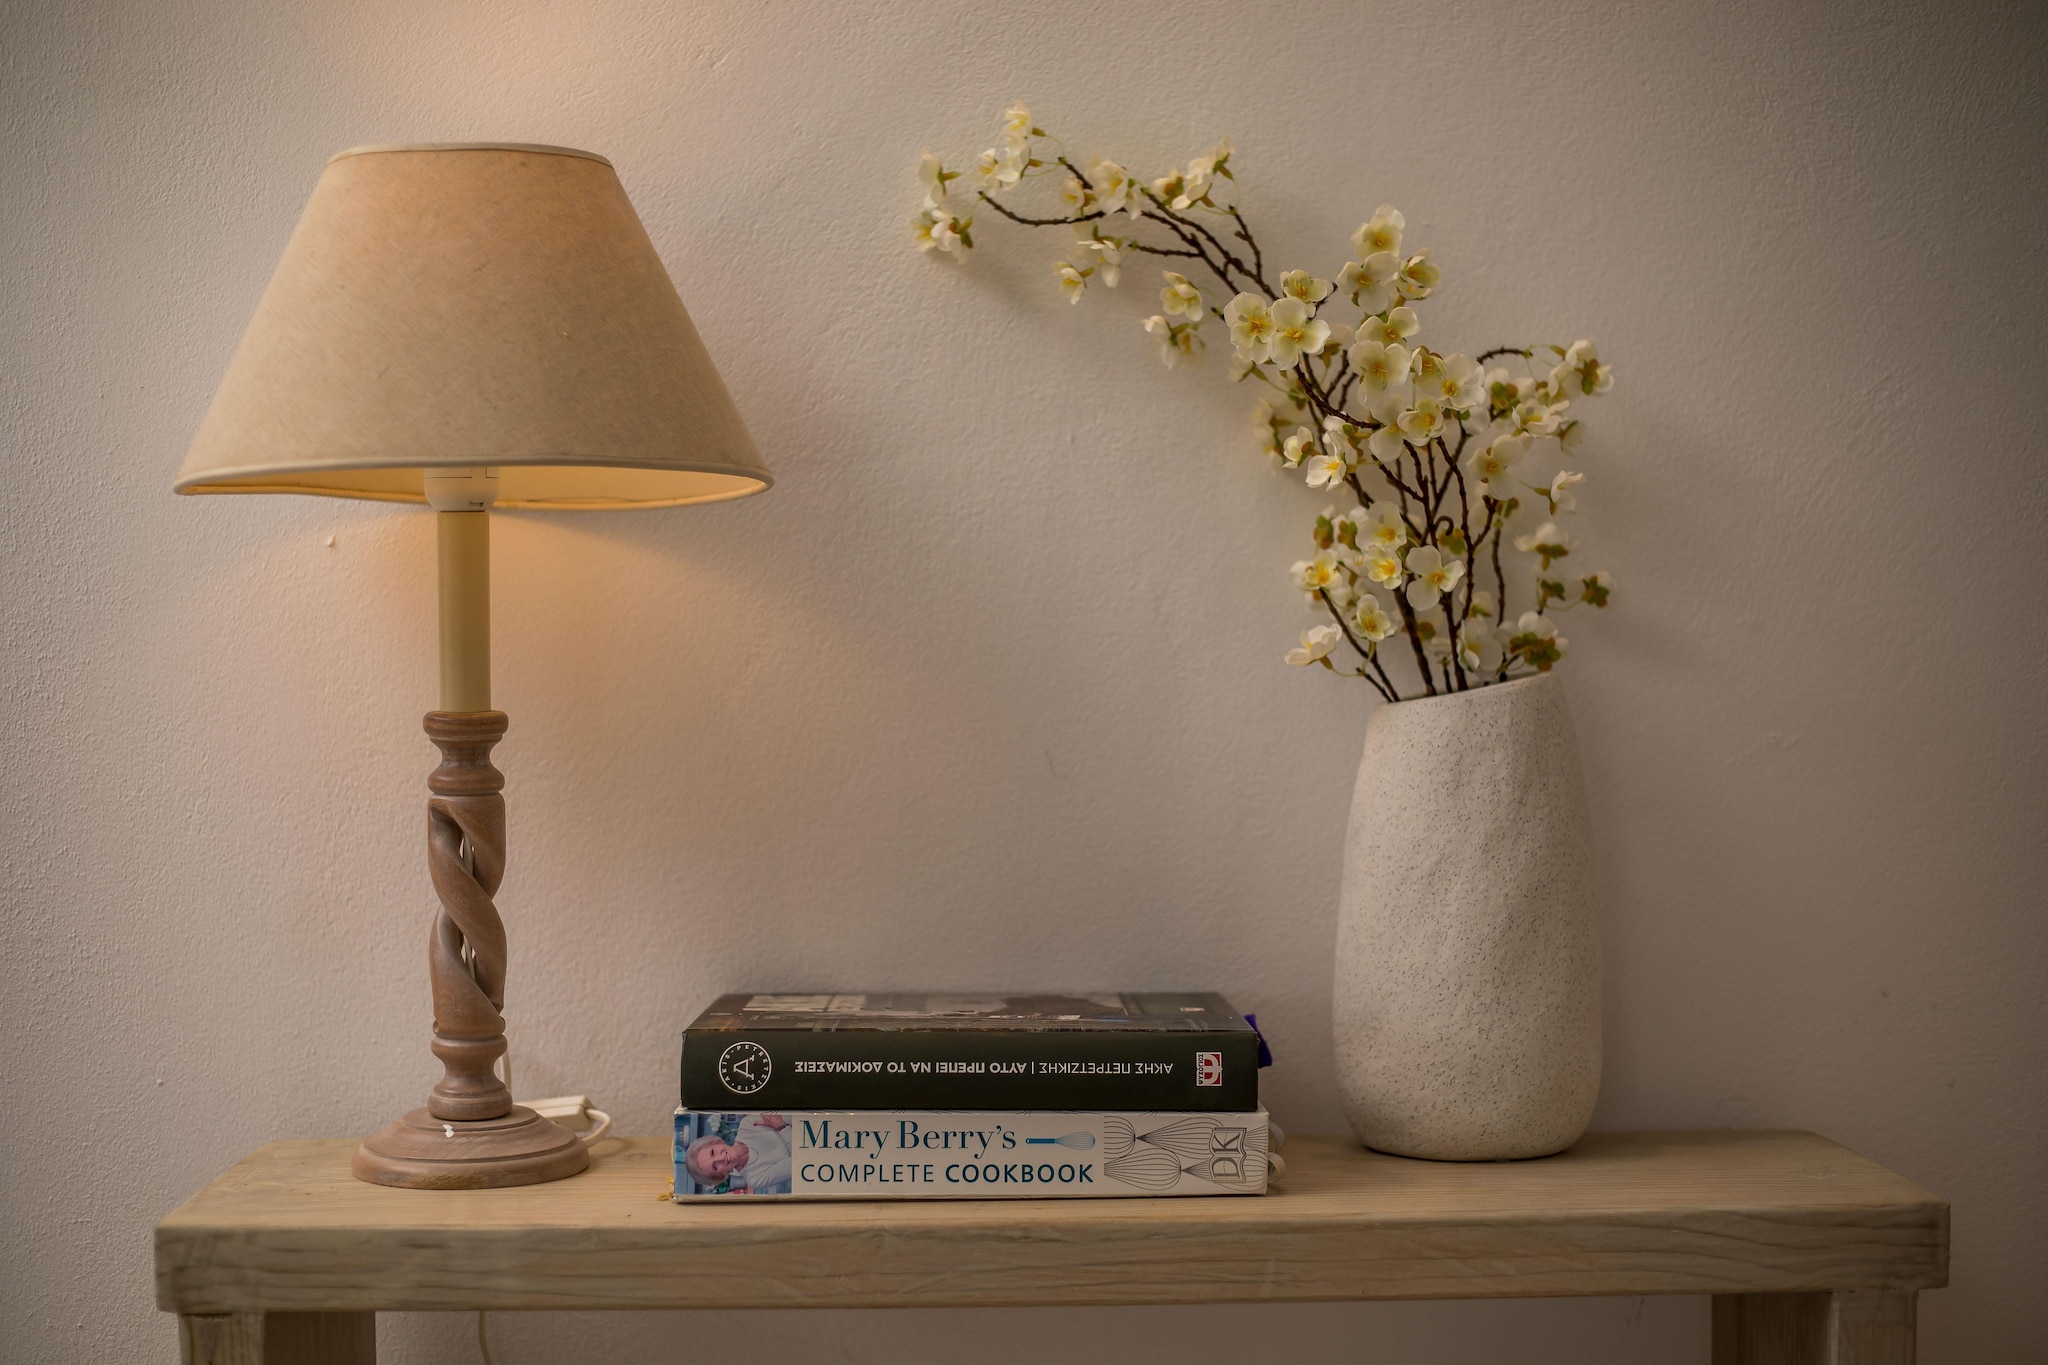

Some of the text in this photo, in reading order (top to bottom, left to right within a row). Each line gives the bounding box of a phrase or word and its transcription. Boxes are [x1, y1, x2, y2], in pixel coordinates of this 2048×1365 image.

[794, 1061, 884, 1073] ΔΟΚΙΜΑΣΕΙΣ
[886, 1061, 907, 1073] ΤΟ
[909, 1061, 932, 1073] ΝΑ
[935, 1062, 985, 1073] ΠΡΕΠΕΙ
[989, 1062, 1028, 1074] ΑΥΤΟ
[1039, 1062, 1131, 1074] ΠΕΤΡΕΤΖΙΚΗΣ
[1135, 1062, 1174, 1074] ΑΚΗΣ
[799, 1119, 1017, 1160] Mary Berry's
[1211, 1132, 1241, 1179] DK
[800, 1163, 1094, 1184] COMPLETE COOKBOOK
